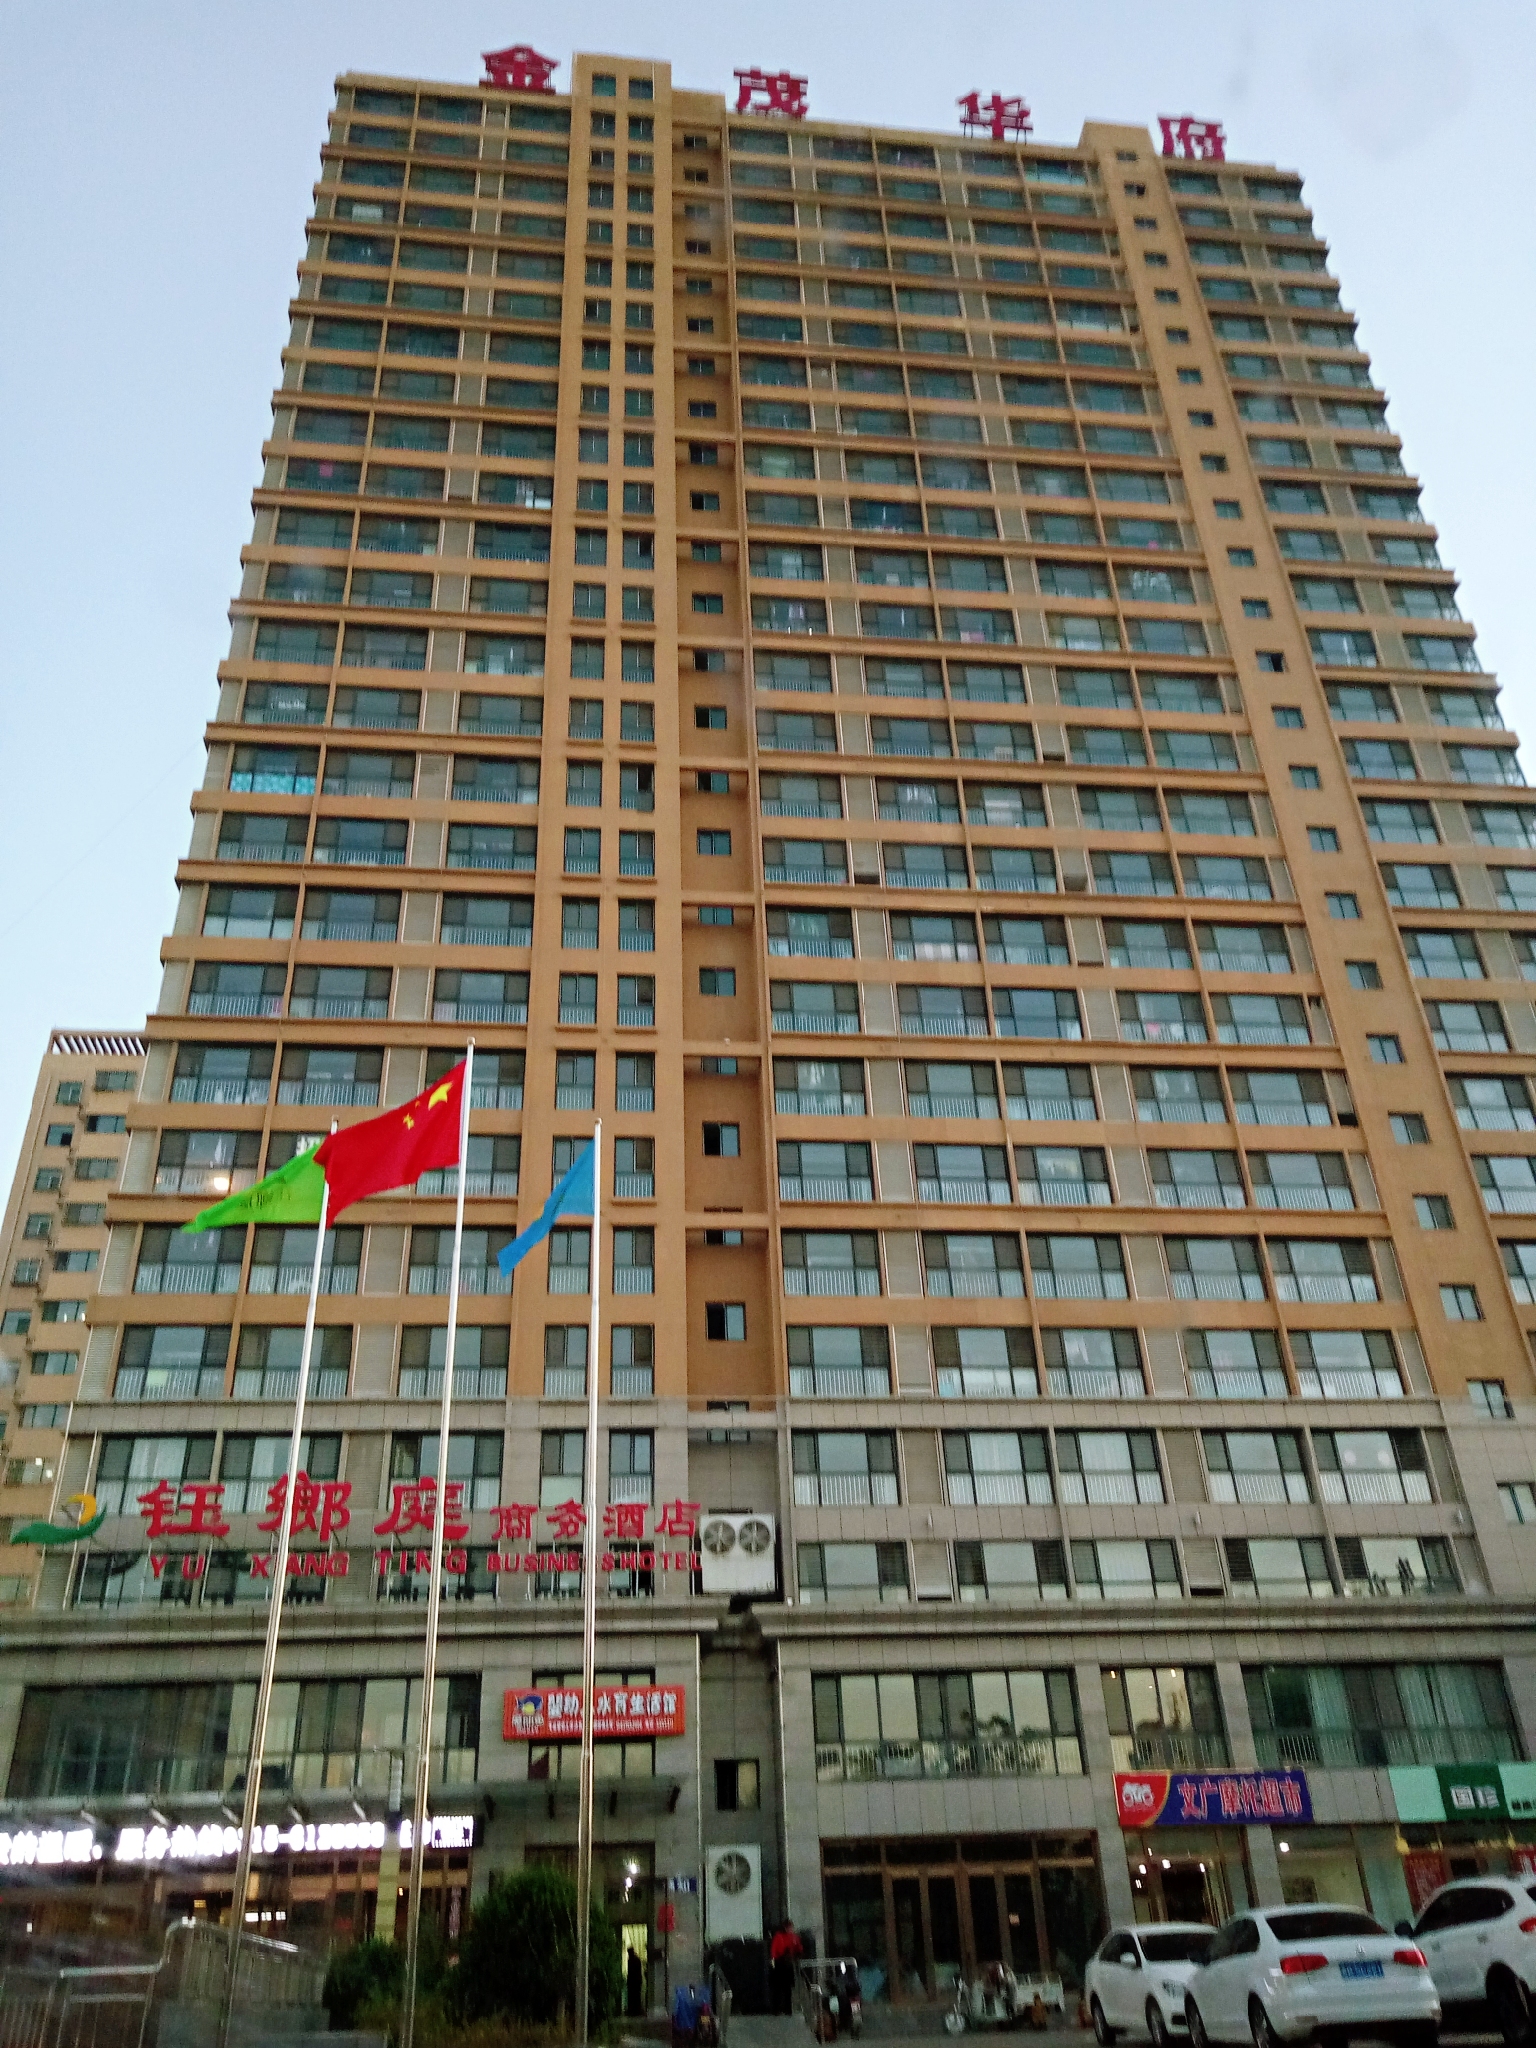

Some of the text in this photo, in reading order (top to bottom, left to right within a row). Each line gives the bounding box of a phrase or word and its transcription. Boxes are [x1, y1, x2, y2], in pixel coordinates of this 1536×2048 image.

[480, 45, 1226, 162] 金茂华府
[489, 1497, 700, 1540] 商务酒店
[150, 1554, 205, 1580] YU
[251, 1552, 349, 1578] XANG
[548, 1691, 677, 1718] 婴幼水育生活馆
[1177, 1776, 1302, 1820] 文广摩托超市
